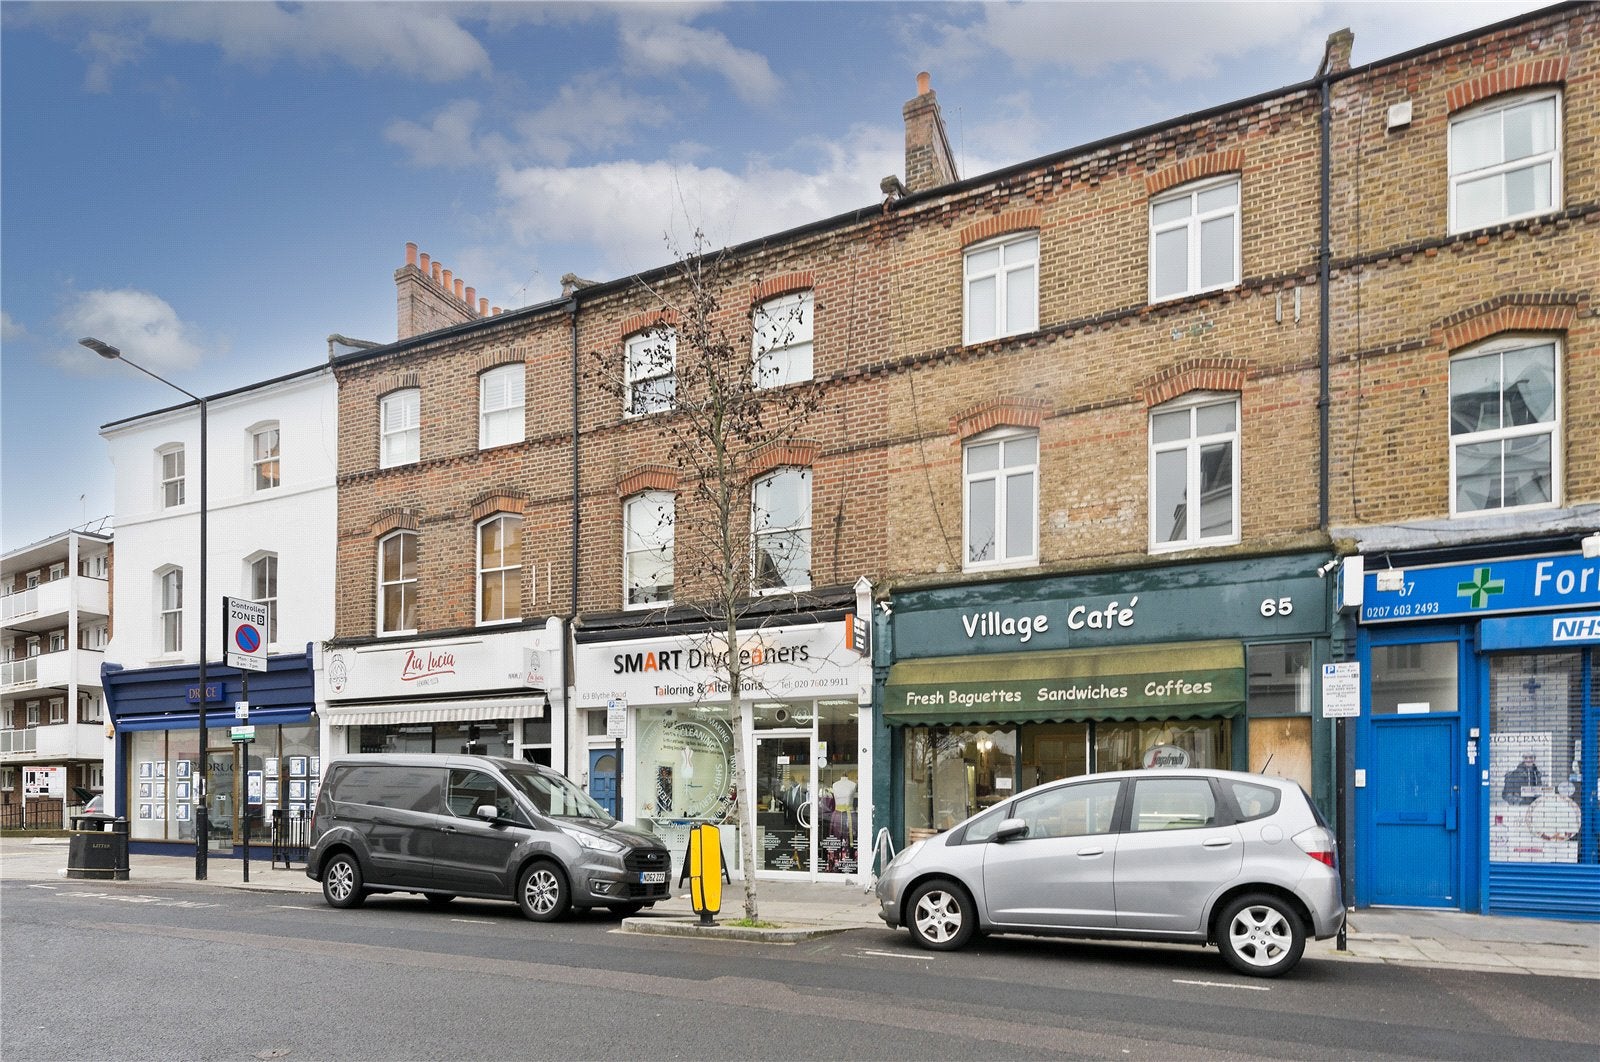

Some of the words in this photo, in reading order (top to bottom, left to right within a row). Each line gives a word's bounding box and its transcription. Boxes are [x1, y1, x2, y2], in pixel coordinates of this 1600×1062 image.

[1535, 561, 1600, 596] For
[231, 600, 266, 614] Controlled
[231, 610, 256, 623] ZONE
[257, 615, 265, 625] B
[1259, 597, 1294, 618] 65
[1366, 606, 1390, 618] 0207
[1393, 604, 1411, 616] 603
[1415, 602, 1439, 613] 2493
[962, 611, 1049, 643] Village
[1067, 596, 1139, 630] Café
[402, 649, 424, 677] Zia
[427, 651, 456, 672] Lucia
[613, 650, 682, 675] SMART
[689, 644, 809, 671] Dryceaners
[189, 687, 217, 699] DRCE
[654, 684, 694, 697] Tailoring
[697, 682, 706, 694] &
[707, 681, 763, 693] Alterions
[794, 680, 809, 689] 020
[810, 679, 828, 688] 7602
[830, 677, 849, 687] 9911
[906, 690, 944, 706] Fresh
[948, 688, 1022, 707] Baguettes
[1036, 684, 1128, 702] Sandwiches
[1144, 680, 1212, 697] Coffees
[582, 692, 590, 700] 63
[591, 691, 610, 700] Blythe
[681, 728, 714, 751] CLEANING
[708, 717, 730, 742] MAKING
[714, 763, 723, 792] SHIRT
